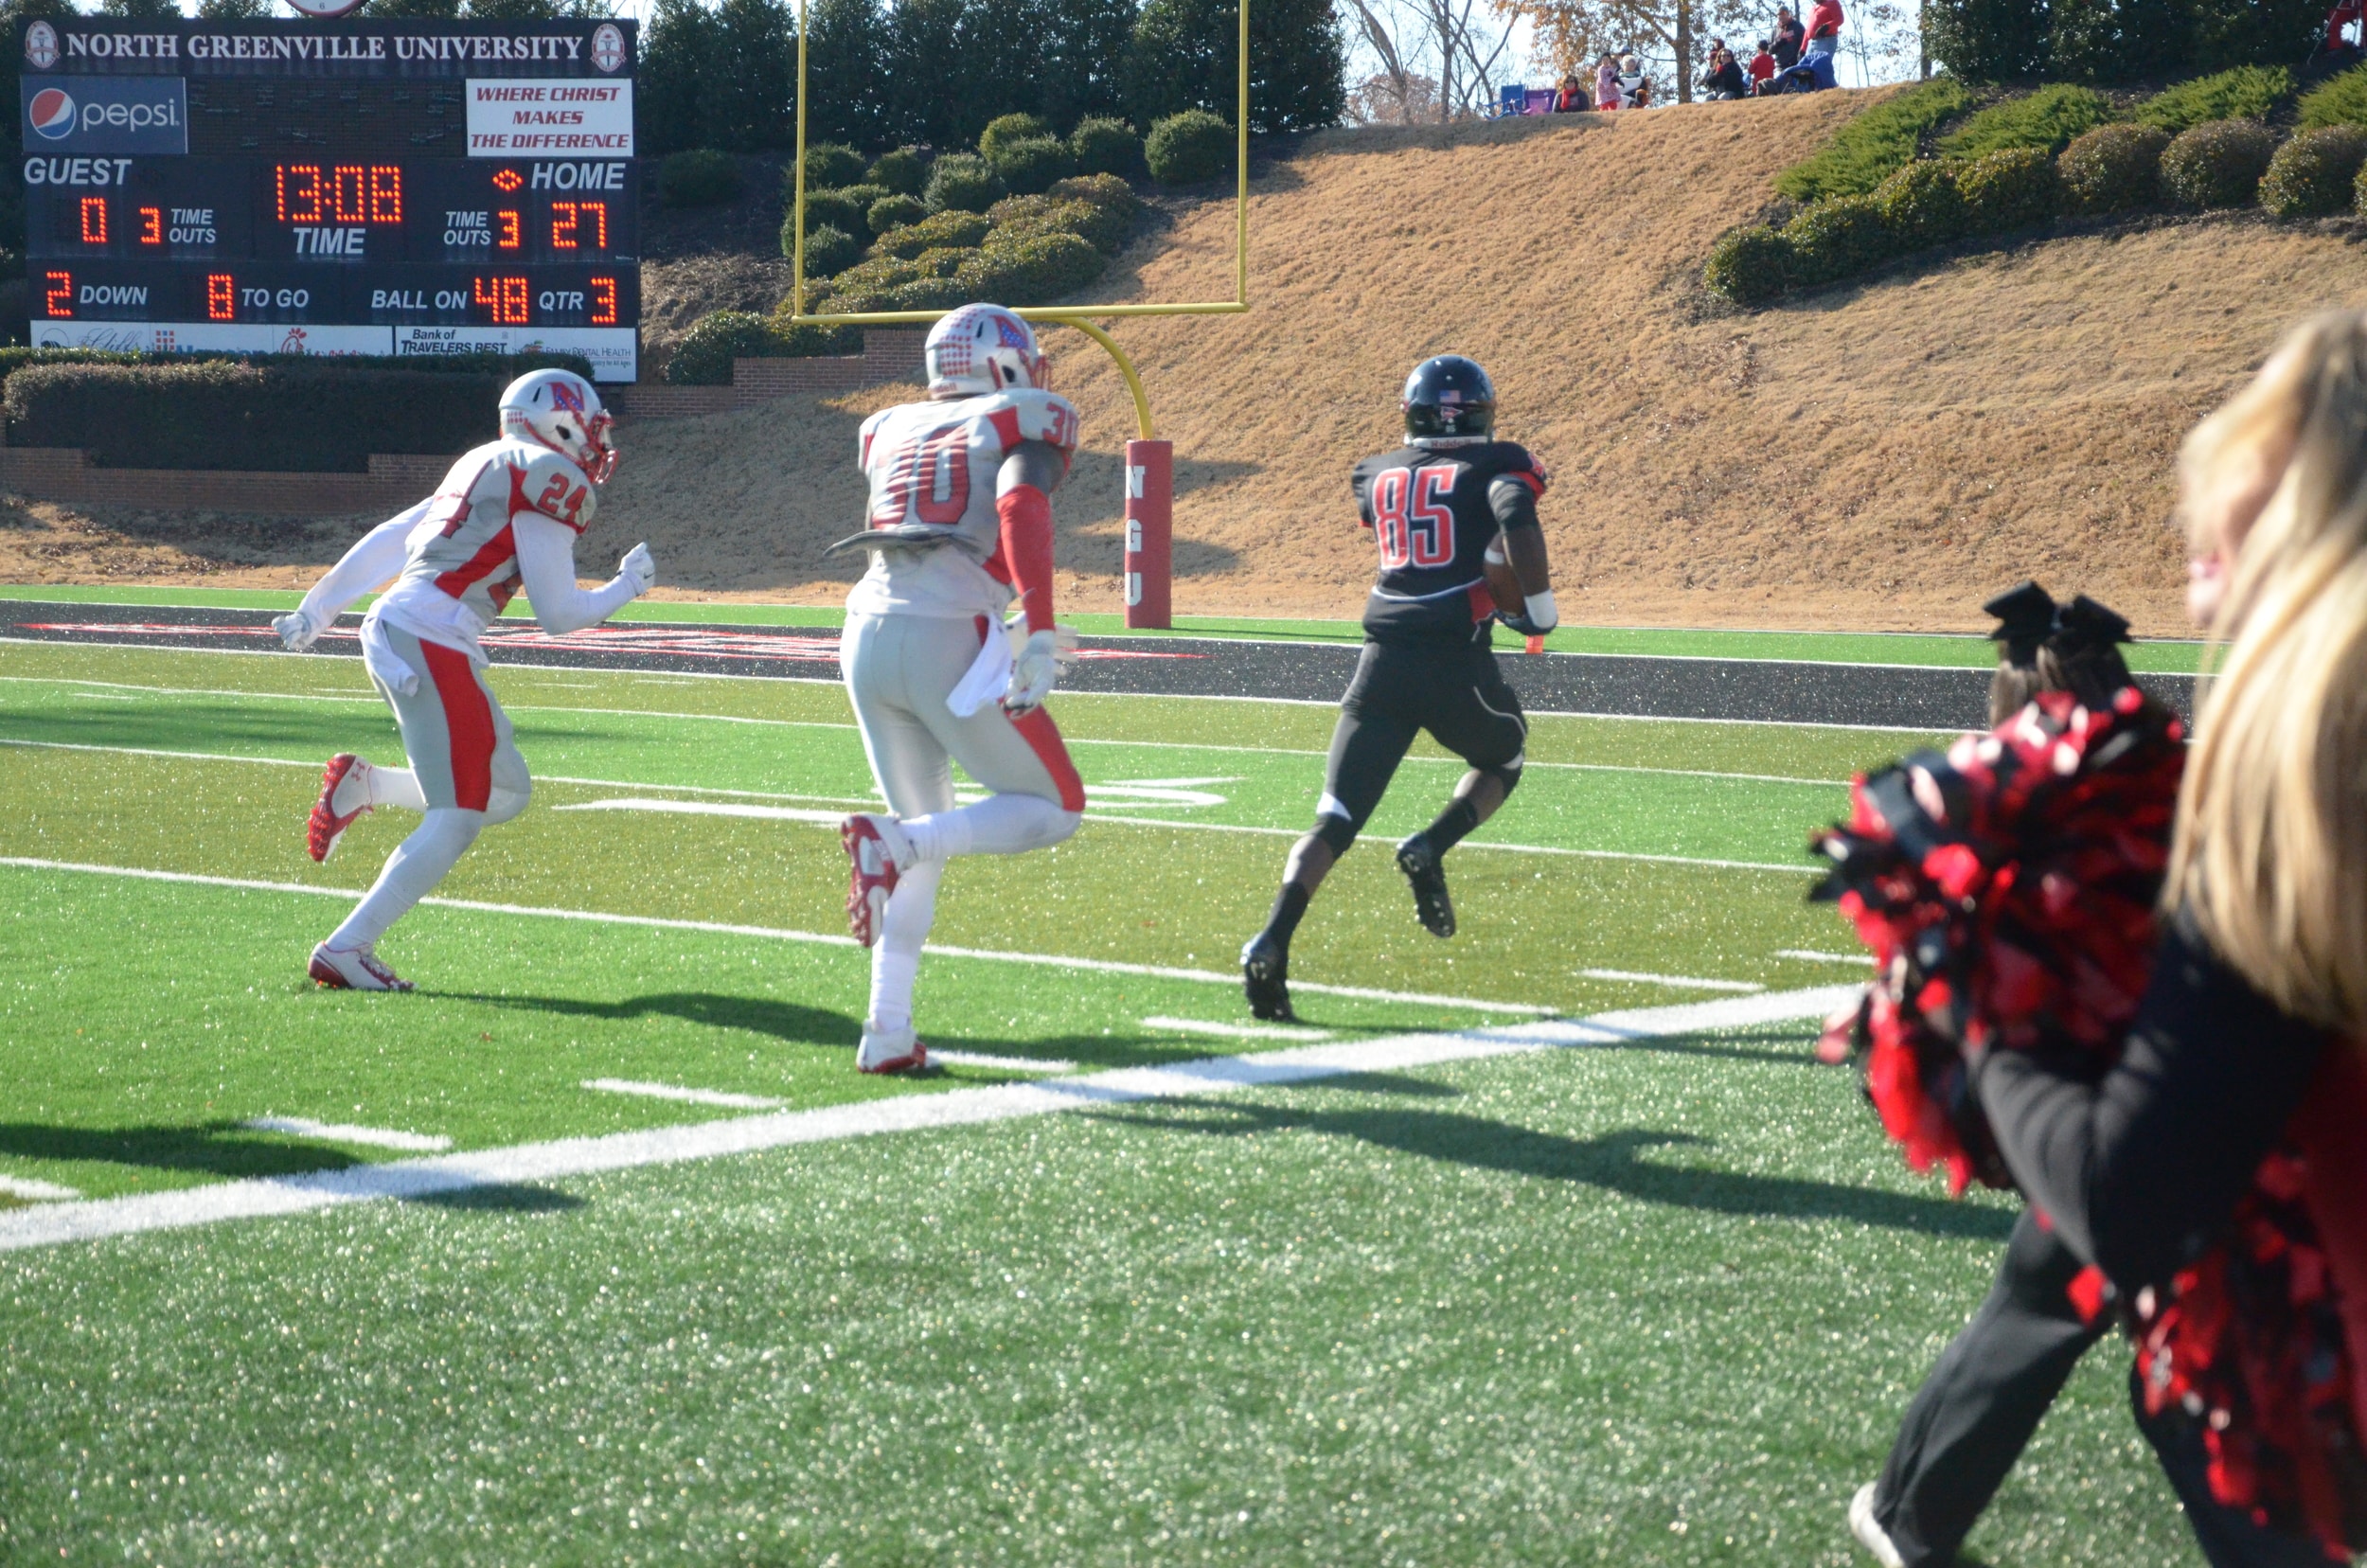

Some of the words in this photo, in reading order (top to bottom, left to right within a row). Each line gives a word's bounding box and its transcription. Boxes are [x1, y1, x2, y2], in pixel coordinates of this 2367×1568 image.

[66, 33, 179, 58] NORTH
[187, 35, 385, 60] GREENVILLE
[394, 36, 583, 60] UNIVERSITY
[476, 87, 546, 101] WHERE
[549, 87, 621, 101] CHRIST
[82, 98, 176, 132] pepsi
[512, 111, 584, 125] MAKES
[472, 134, 508, 148] THE
[510, 134, 630, 149] DIFFERENCE
[24, 157, 133, 185] GUEST
[531, 162, 626, 189] HOME
[276, 165, 401, 223] 13:08
[81, 197, 106, 243] 0
[139, 206, 161, 244] 3
[170, 208, 213, 225] TIME
[445, 211, 488, 227] TIME
[498, 210, 520, 248] 3
[552, 202, 607, 248] 27
[169, 227, 217, 243] OUTS
[293, 226, 366, 255] TIME
[443, 230, 491, 245] OUTS
[46, 271, 72, 316] 2
[80, 285, 148, 305] DOWN
[207, 274, 234, 319] 8
[241, 288, 270, 308] TO
[276, 289, 310, 308] GO
[371, 290, 428, 309] BALL
[435, 291, 468, 310] ON
[474, 277, 529, 323] 48
[539, 291, 584, 312] QTR
[591, 277, 616, 323] 3
[412, 329, 441, 340] Bank
[444, 329, 456, 340] of
[474, 342, 507, 353] REST
[601, 347, 632, 356] HEALTH
[537, 472, 588, 522] 24
[1372, 464, 1459, 570] 85
